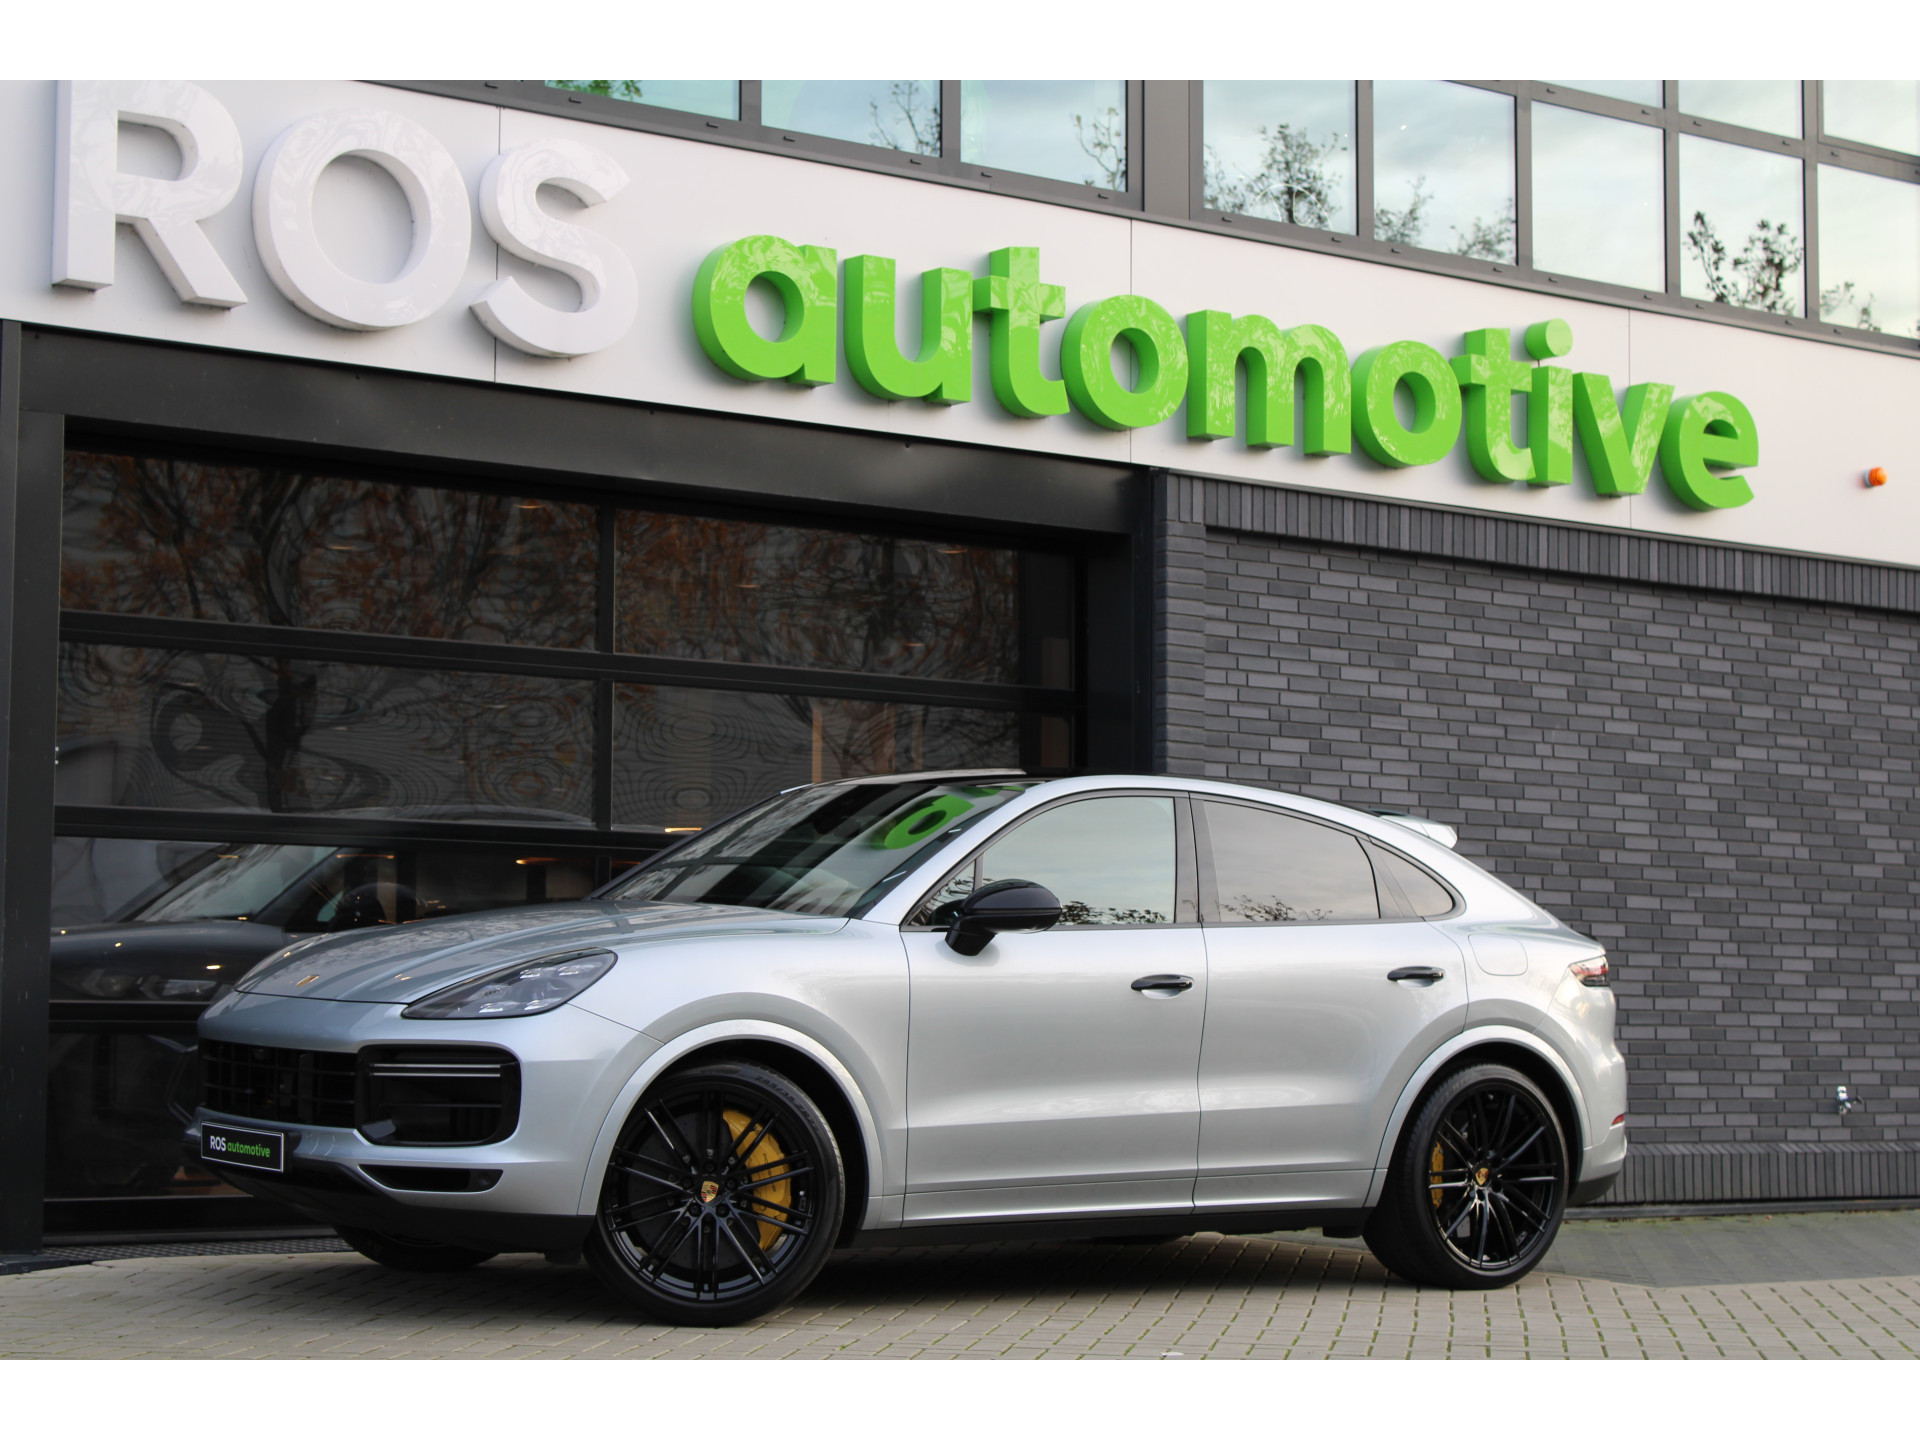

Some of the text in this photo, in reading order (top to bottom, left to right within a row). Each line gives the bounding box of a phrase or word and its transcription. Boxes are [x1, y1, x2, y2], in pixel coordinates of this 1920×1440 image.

[52, 81, 1759, 511] ROS automotive
[210, 1135, 271, 1157] ROS automotive
